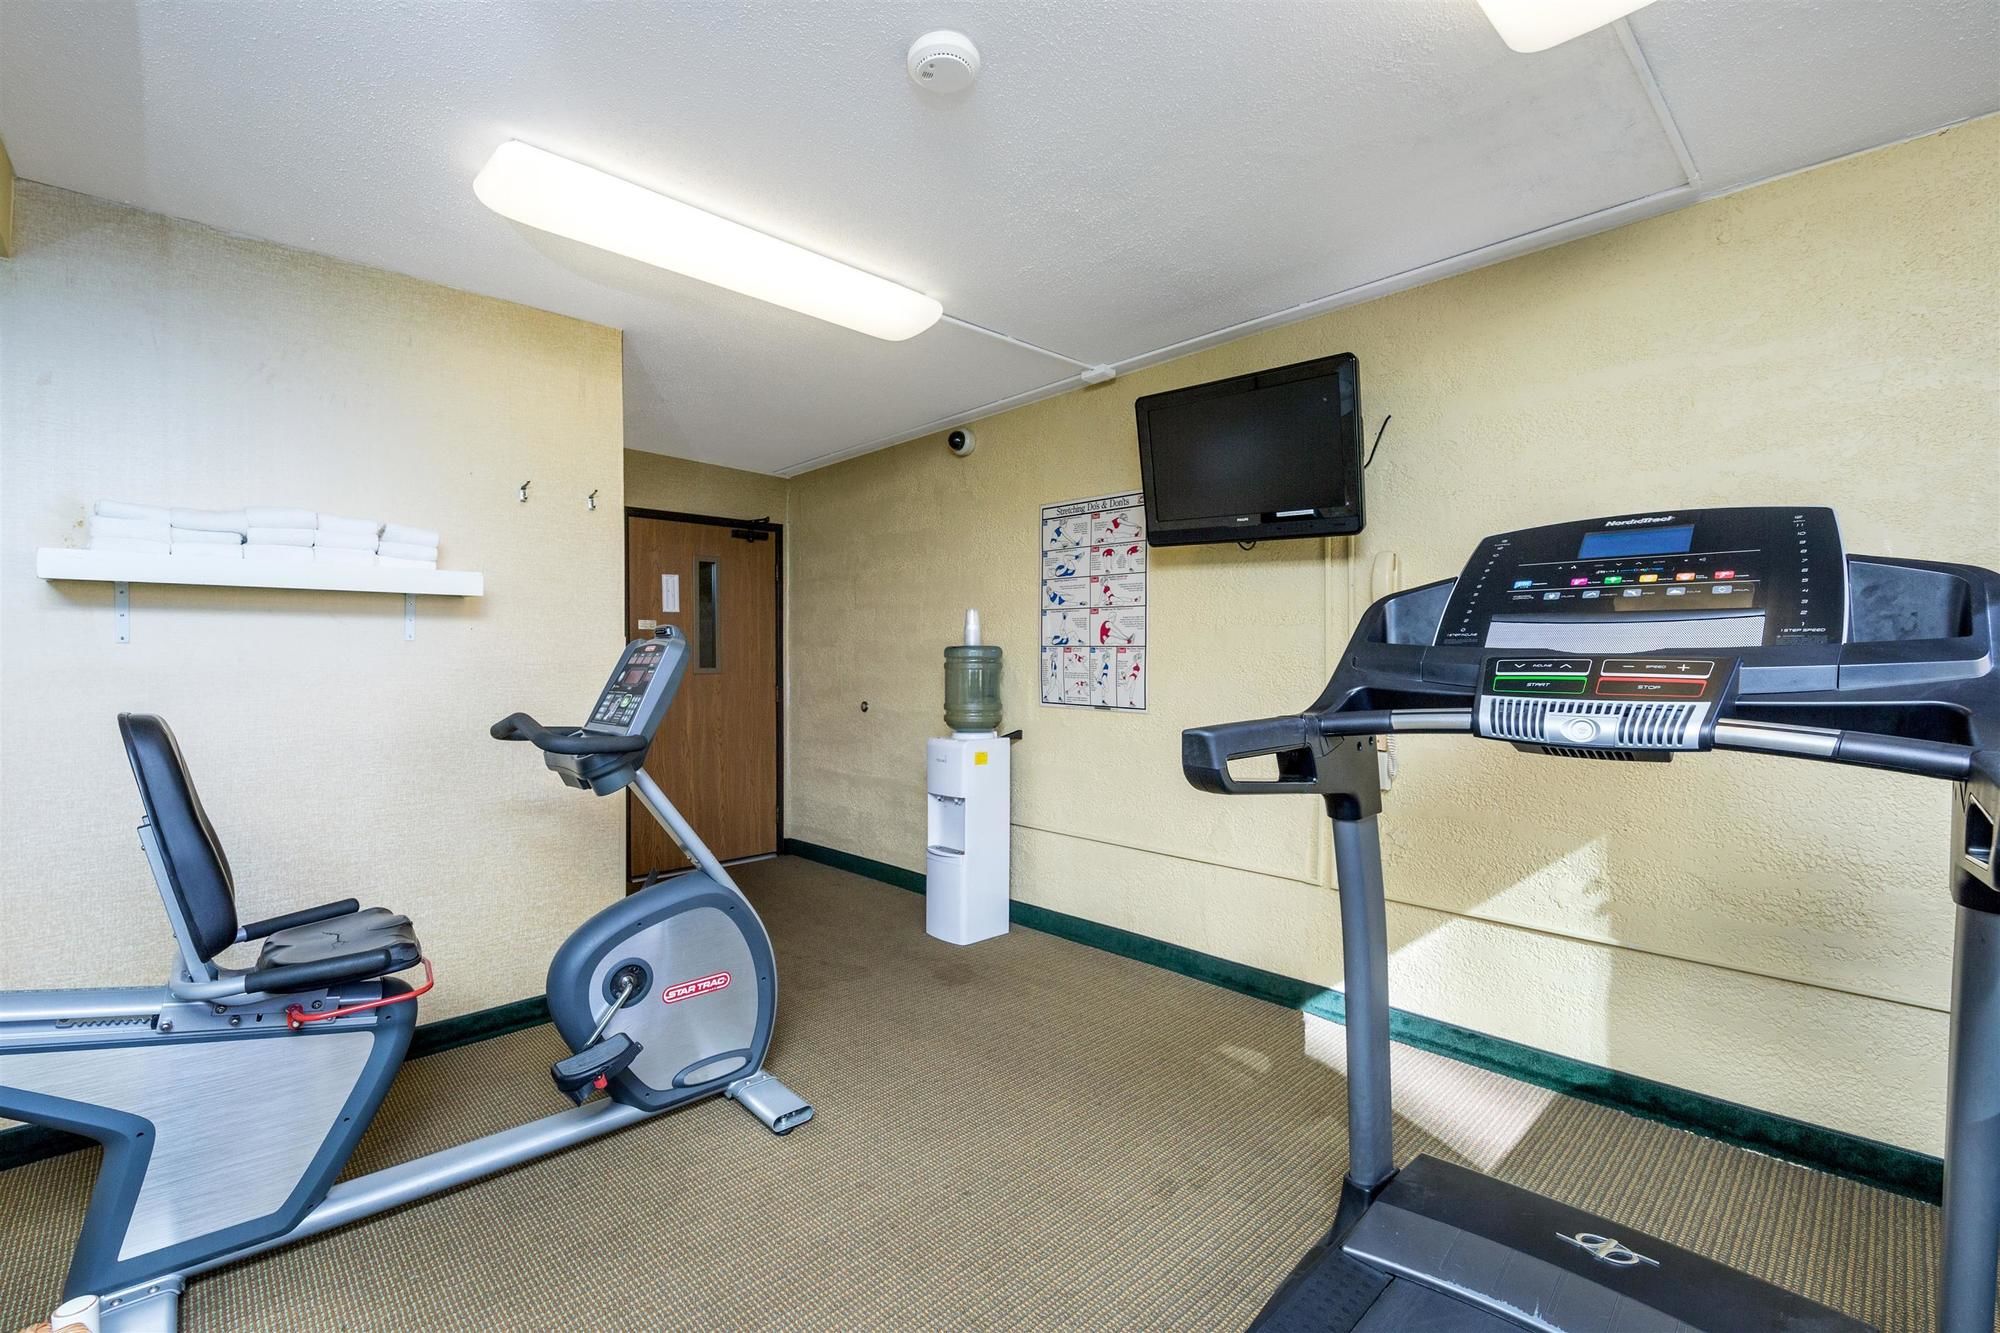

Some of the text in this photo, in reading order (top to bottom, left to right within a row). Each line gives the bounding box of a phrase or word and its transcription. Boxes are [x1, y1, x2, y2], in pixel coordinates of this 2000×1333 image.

[1056, 505, 1086, 516] Stretching
[1605, 515, 1674, 527] NordicTrack
[668, 977, 725, 998] STAR TRAC
